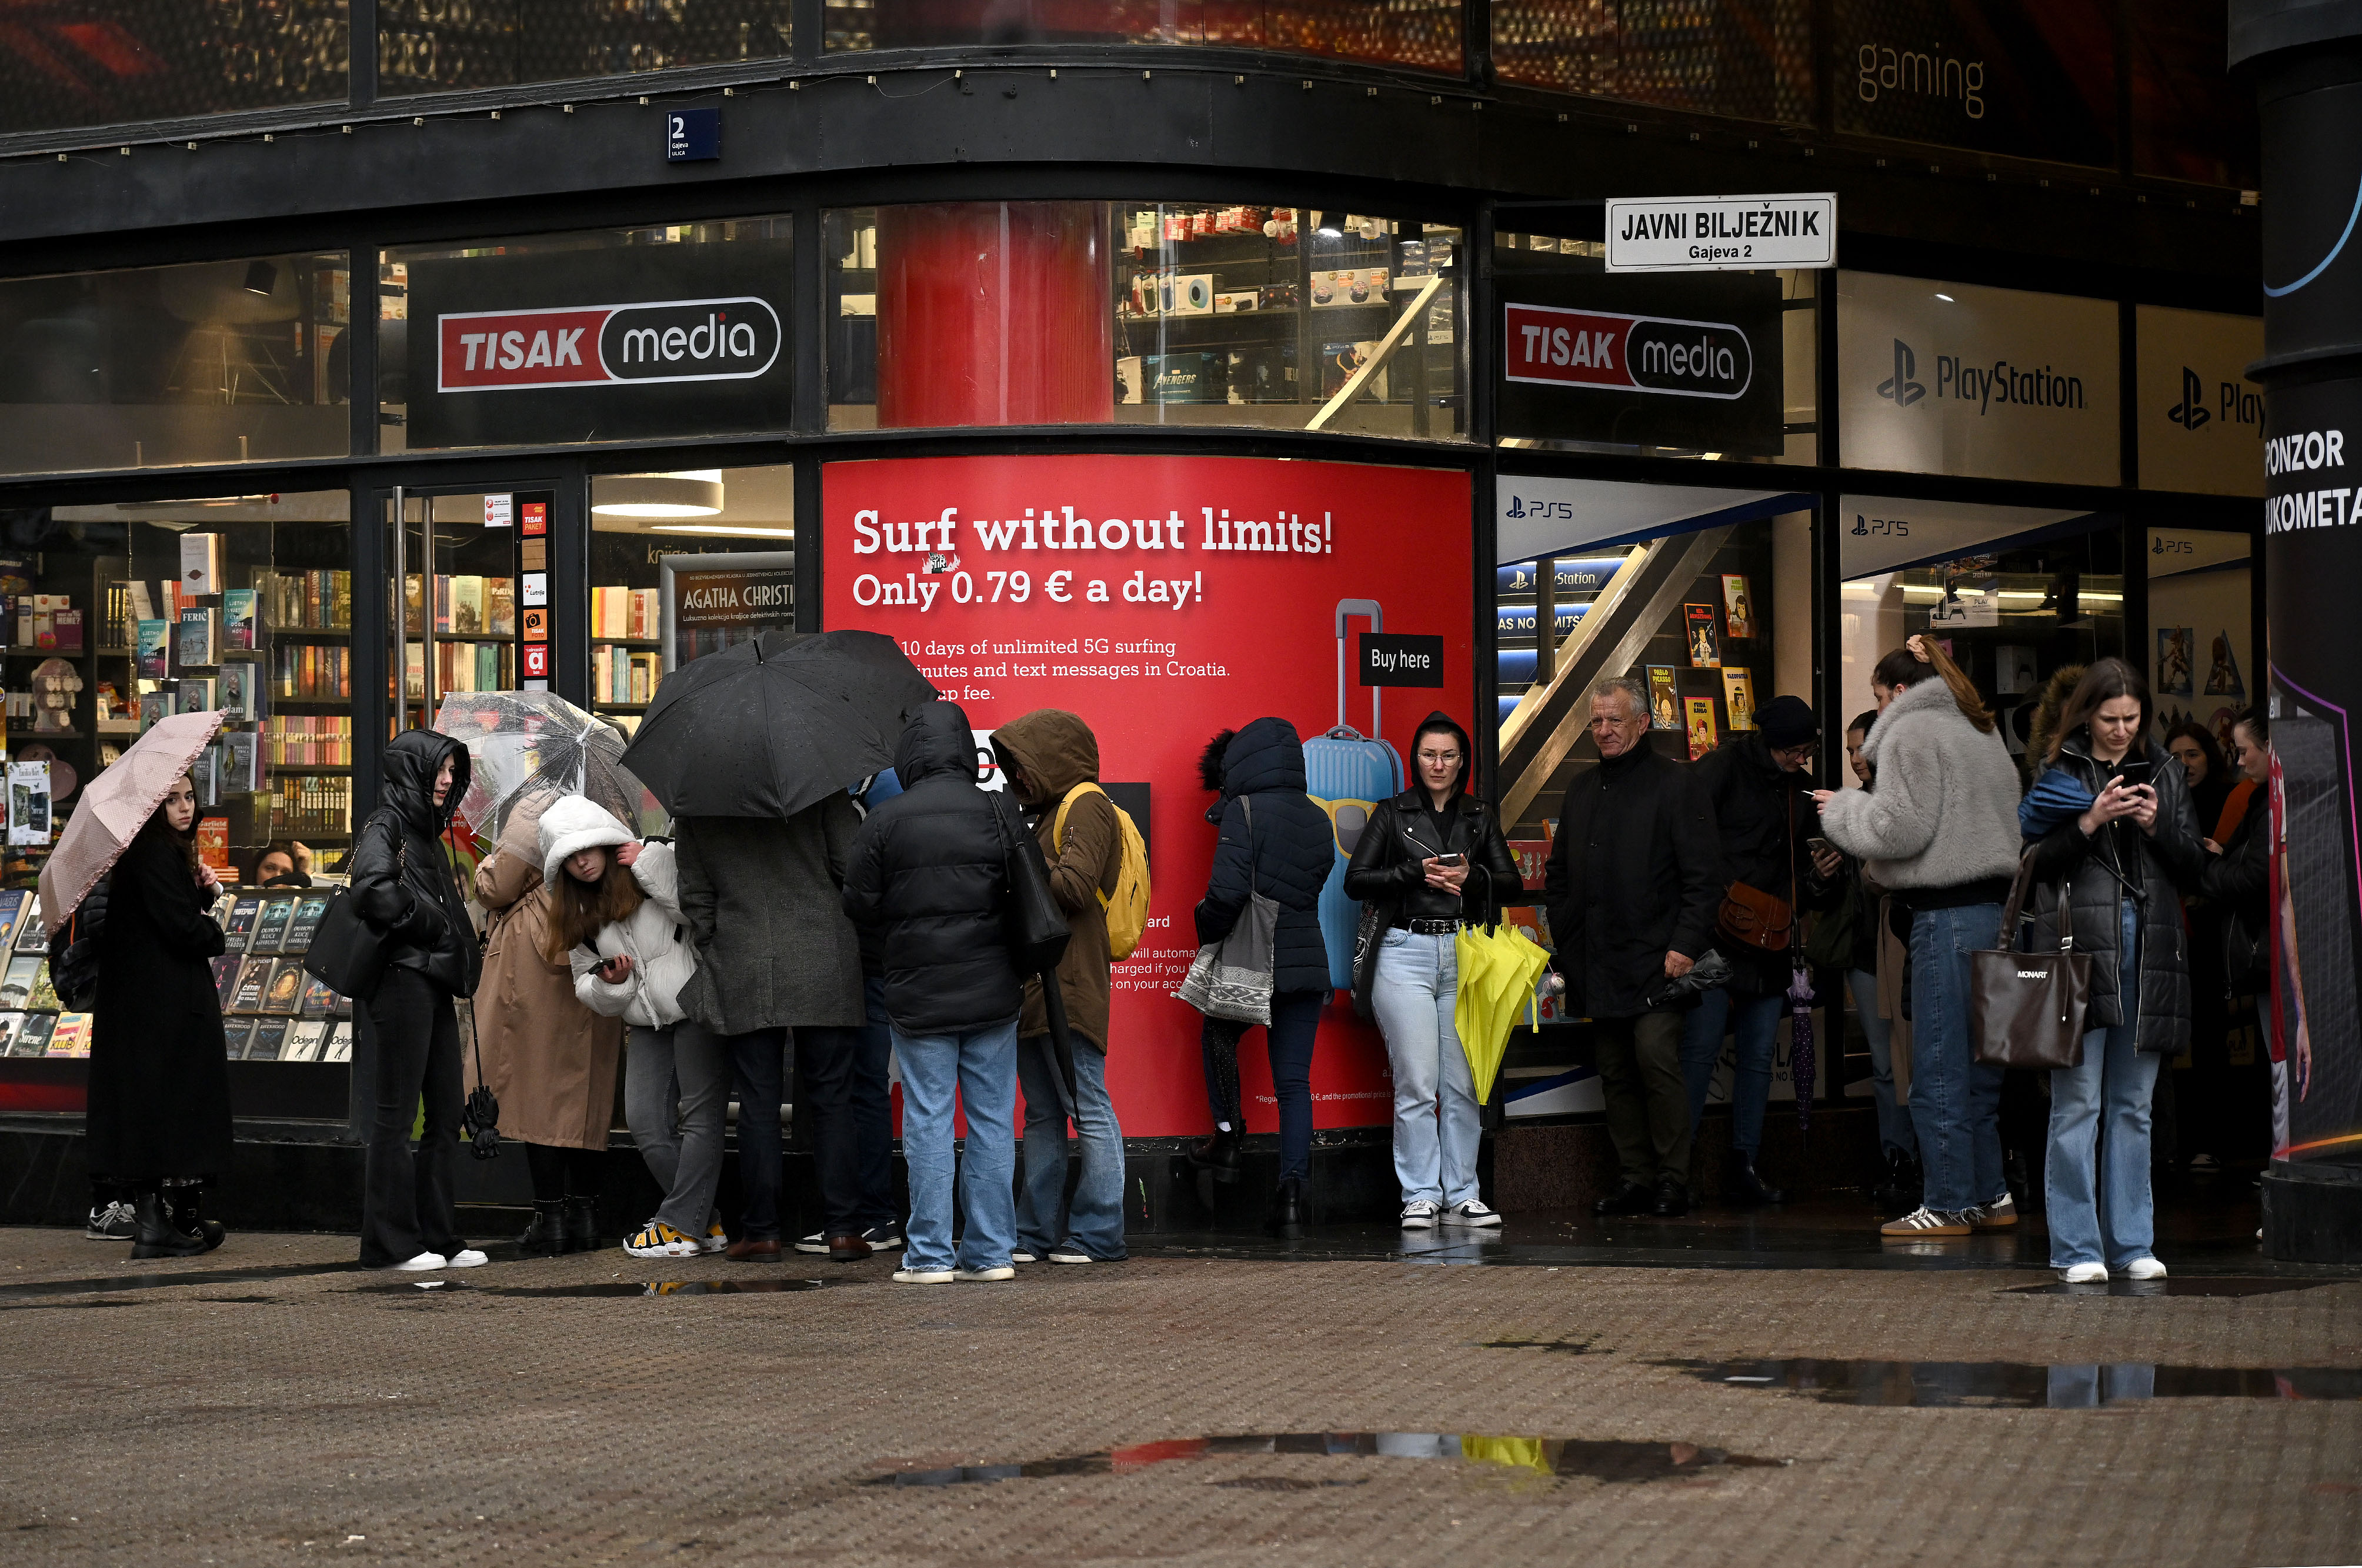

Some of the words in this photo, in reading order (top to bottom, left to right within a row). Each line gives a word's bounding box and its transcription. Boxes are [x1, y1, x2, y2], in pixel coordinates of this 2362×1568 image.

[1859, 42, 1984, 119] gaming
[672, 117, 684, 139] 2
[1622, 212, 1687, 241] JAVNI
[1695, 202, 1820, 239] BILJEŽNIK
[1689, 245, 1739, 261] Gajeva
[1743, 245, 1752, 258] 2
[460, 327, 586, 371] TISAK
[623, 312, 755, 363] media
[1521, 325, 1616, 369] TISAK
[1643, 335, 1735, 379] media
[1153, 373, 1196, 389] AVENGERS
[1937, 355, 2083, 415] PlayStation
[2266, 430, 2344, 478] PONZOR
[1530, 501, 1572, 519] PS5
[2266, 487, 2362, 535] UKOMETA
[853, 508, 958, 553] Surf
[973, 506, 1185, 551] without
[1202, 508, 1332, 553] limits!
[1871, 519, 1909, 536] PS5
[2166, 541, 2193, 553] PS5
[1533, 572, 1596, 585] Station
[684, 587, 739, 609] AGATHA
[743, 584, 793, 606] CHRISTI
[853, 573, 940, 612] Only
[952, 571, 1031, 603] 0.79
[1045, 571, 1073, 603] €
[1086, 580, 1110, 603] a
[1122, 571, 1202, 611] day!
[183, 611, 206, 621] FERIĆ
[1497, 618, 1514, 630] AS
[1518, 618, 1536, 629] NO
[902, 641, 920, 656] 10
[925, 640, 965, 658] days
[970, 639, 987, 655] of
[989, 639, 1078, 655] unlimited
[1084, 638, 1109, 653] 5G
[1115, 638, 1176, 657] surfing
[1372, 649, 1396, 672] Buy
[1400, 649, 1430, 668] here
[918, 663, 968, 678] inutes
[973, 662, 1007, 677] and
[1013, 664, 1047, 677] text
[1052, 665, 1139, 680] messages
[1145, 662, 1161, 676] in
[1166, 661, 1230, 676] Croatia.
[963, 686, 995, 700] fee.
[222, 705, 243, 713] Adam
[1146, 915, 1170, 928] ard
[1131, 948, 1149, 958] will
[1152, 948, 1197, 958] automa
[1110, 963, 1152, 976] harged
[1155, 963, 1163, 973] if
[1165, 965, 1185, 976] you
[2017, 970, 2047, 979] MONART
[1116, 980, 1130, 989] on
[1133, 980, 1159, 992] your
[1162, 980, 1182, 989] acc
[19, 1029, 42, 1045] Sirene
[292, 1035, 319, 1045] Odeon
[1776, 1071, 1788, 1081] NO
[1256, 1095, 1277, 1104] Regu
[1343, 1092, 1373, 1101] promotional
[1373, 1091, 1386, 1099] price
